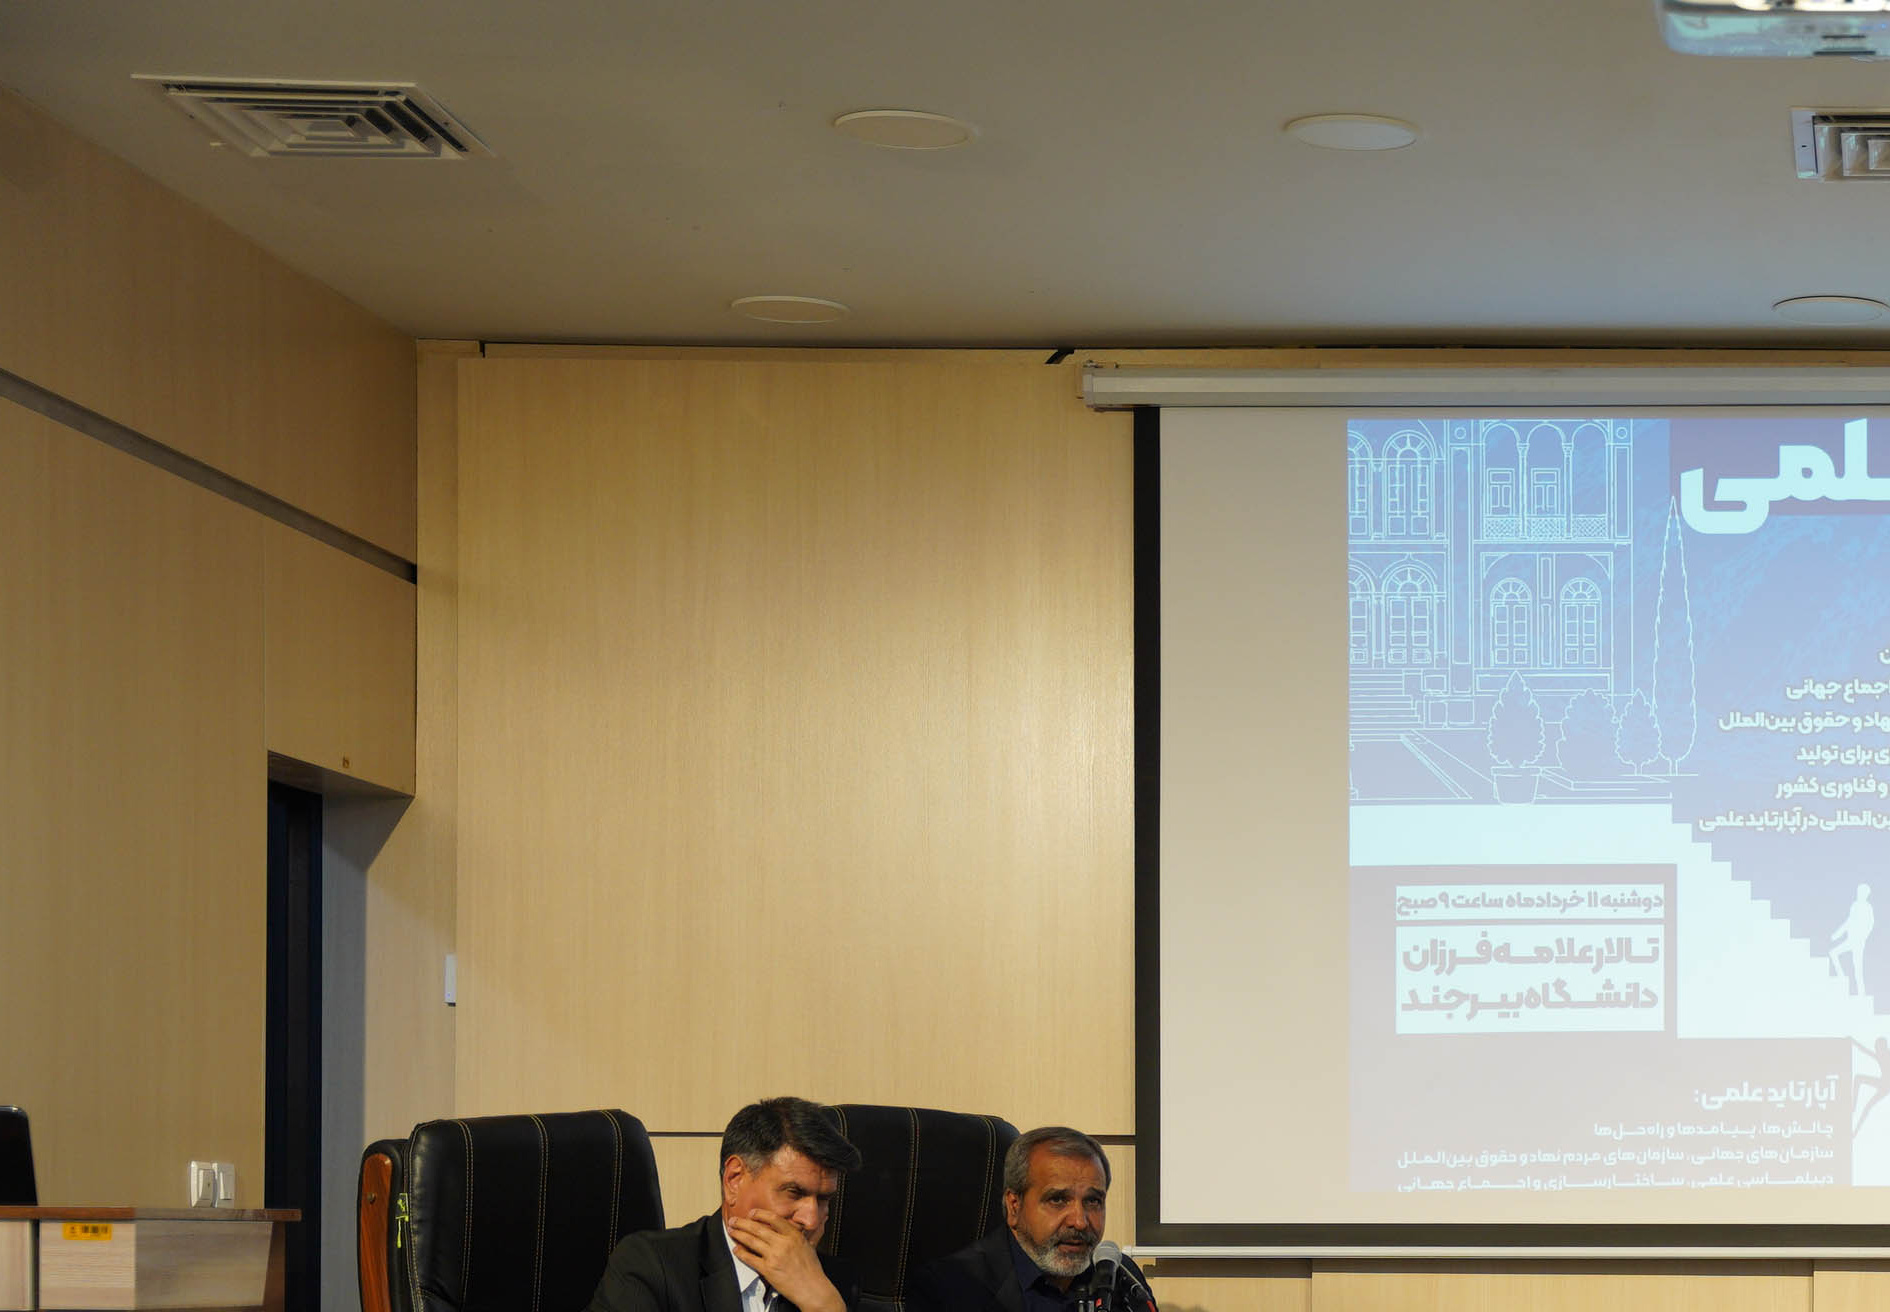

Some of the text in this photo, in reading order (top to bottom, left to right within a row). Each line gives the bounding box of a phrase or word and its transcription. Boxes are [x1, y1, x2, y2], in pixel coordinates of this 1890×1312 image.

[1852, 719, 1862, 734] و
[1878, 784, 1888, 800] و
[1396, 894, 1438, 916] صبح
[1439, 891, 1449, 908] ۹
[1452, 891, 1504, 908] ساعت
[1601, 890, 1663, 913] دوشنبه
[1402, 930, 1659, 975] تالار علامه فرزان
[1402, 978, 1658, 1021] دانشگاه بیرجند
[1766, 1075, 1838, 1110] آپارتاید
[1666, 1126, 1675, 1139] و
[1521, 1152, 1528, 1166] و
